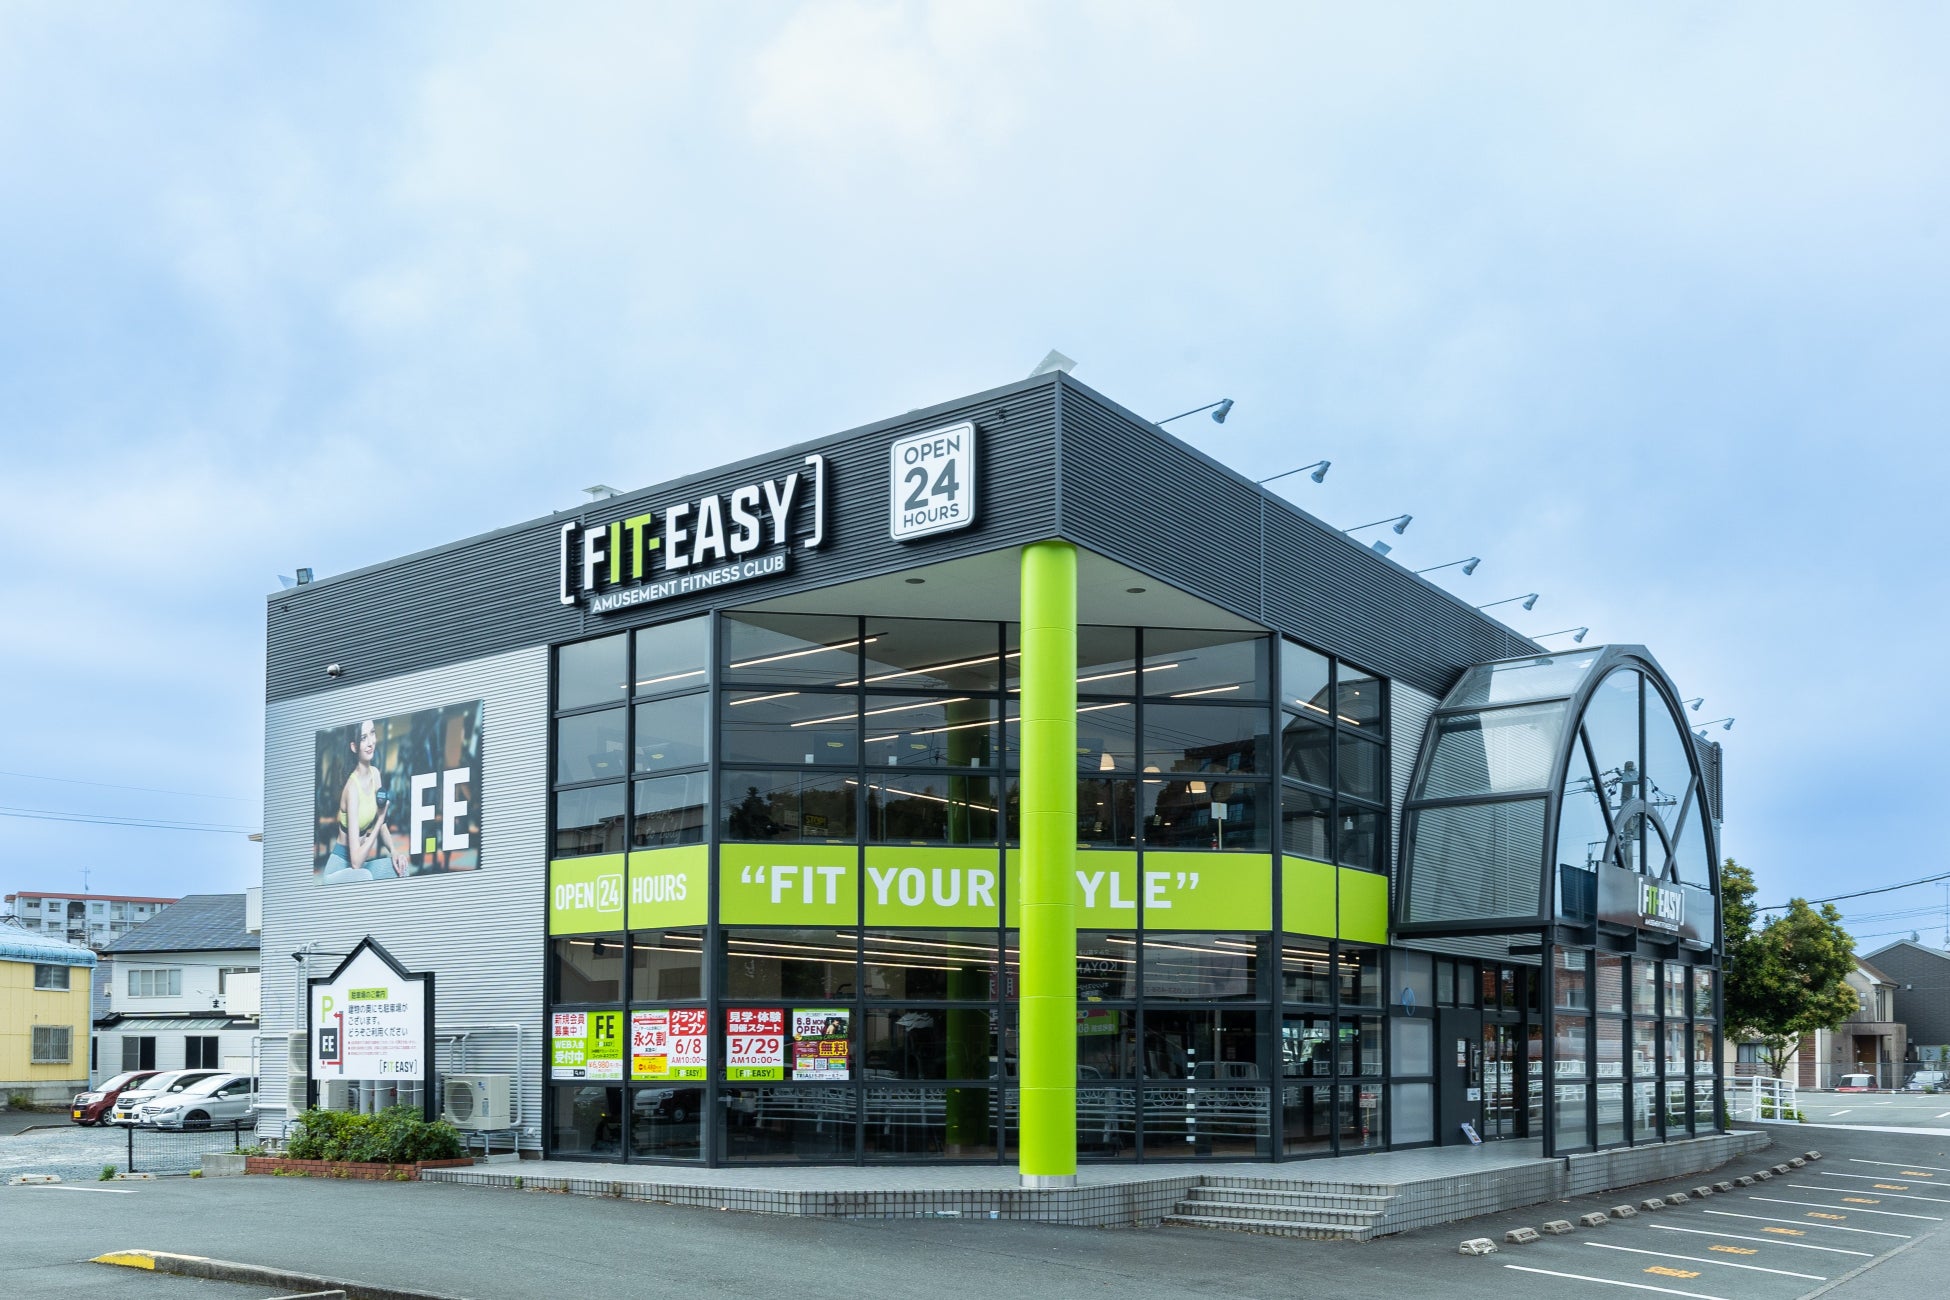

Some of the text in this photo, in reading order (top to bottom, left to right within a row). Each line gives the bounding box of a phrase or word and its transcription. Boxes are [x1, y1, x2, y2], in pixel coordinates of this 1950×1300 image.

[904, 434, 960, 465] OPEN
[903, 458, 960, 512] 24
[903, 503, 959, 528] HOURS
[592, 555, 785, 613] AMUSEMENT FITNESS CLUB
[555, 873, 687, 910] OPEN 24 HOURS
[867, 867, 995, 906] YOUR
[322, 996, 334, 1023] P
[672, 1011, 706, 1022] グランド
[729, 1011, 782, 1022] 見学・体験
[554, 1014, 585, 1025] 新規会員
[672, 1023, 706, 1035] オープン
[729, 1024, 782, 1033] 開催スタート
[796, 1026, 822, 1034] OPEN
[634, 1031, 667, 1047] 永久割
[675, 1038, 702, 1054] 6/8
[732, 1038, 779, 1054] 5/29
[820, 1041, 848, 1056] 無料
[554, 1051, 585, 1065] 受付中
